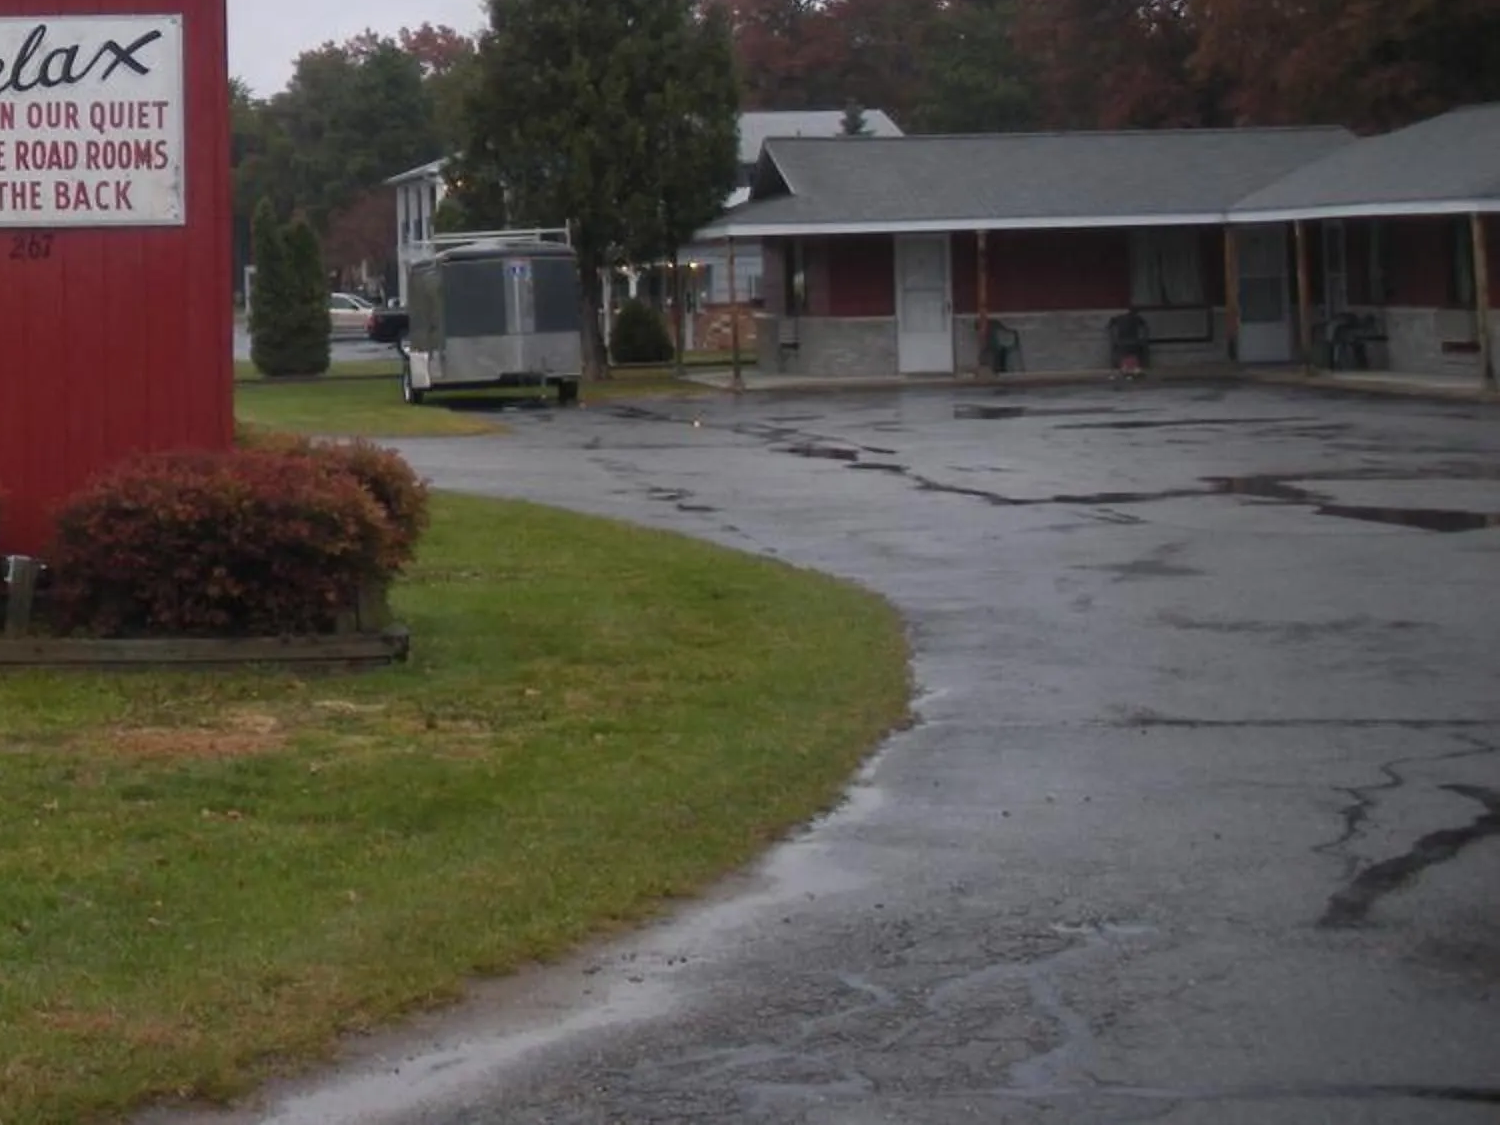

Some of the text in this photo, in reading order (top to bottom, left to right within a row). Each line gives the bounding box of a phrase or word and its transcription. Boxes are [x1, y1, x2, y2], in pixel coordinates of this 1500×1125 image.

[27, 102, 80, 130] OUR
[89, 101, 169, 134] QUIET
[15, 141, 78, 171] ROAD
[86, 139, 169, 171] ROOMS
[54, 180, 133, 211] BACK
[8, 235, 55, 260] 267
